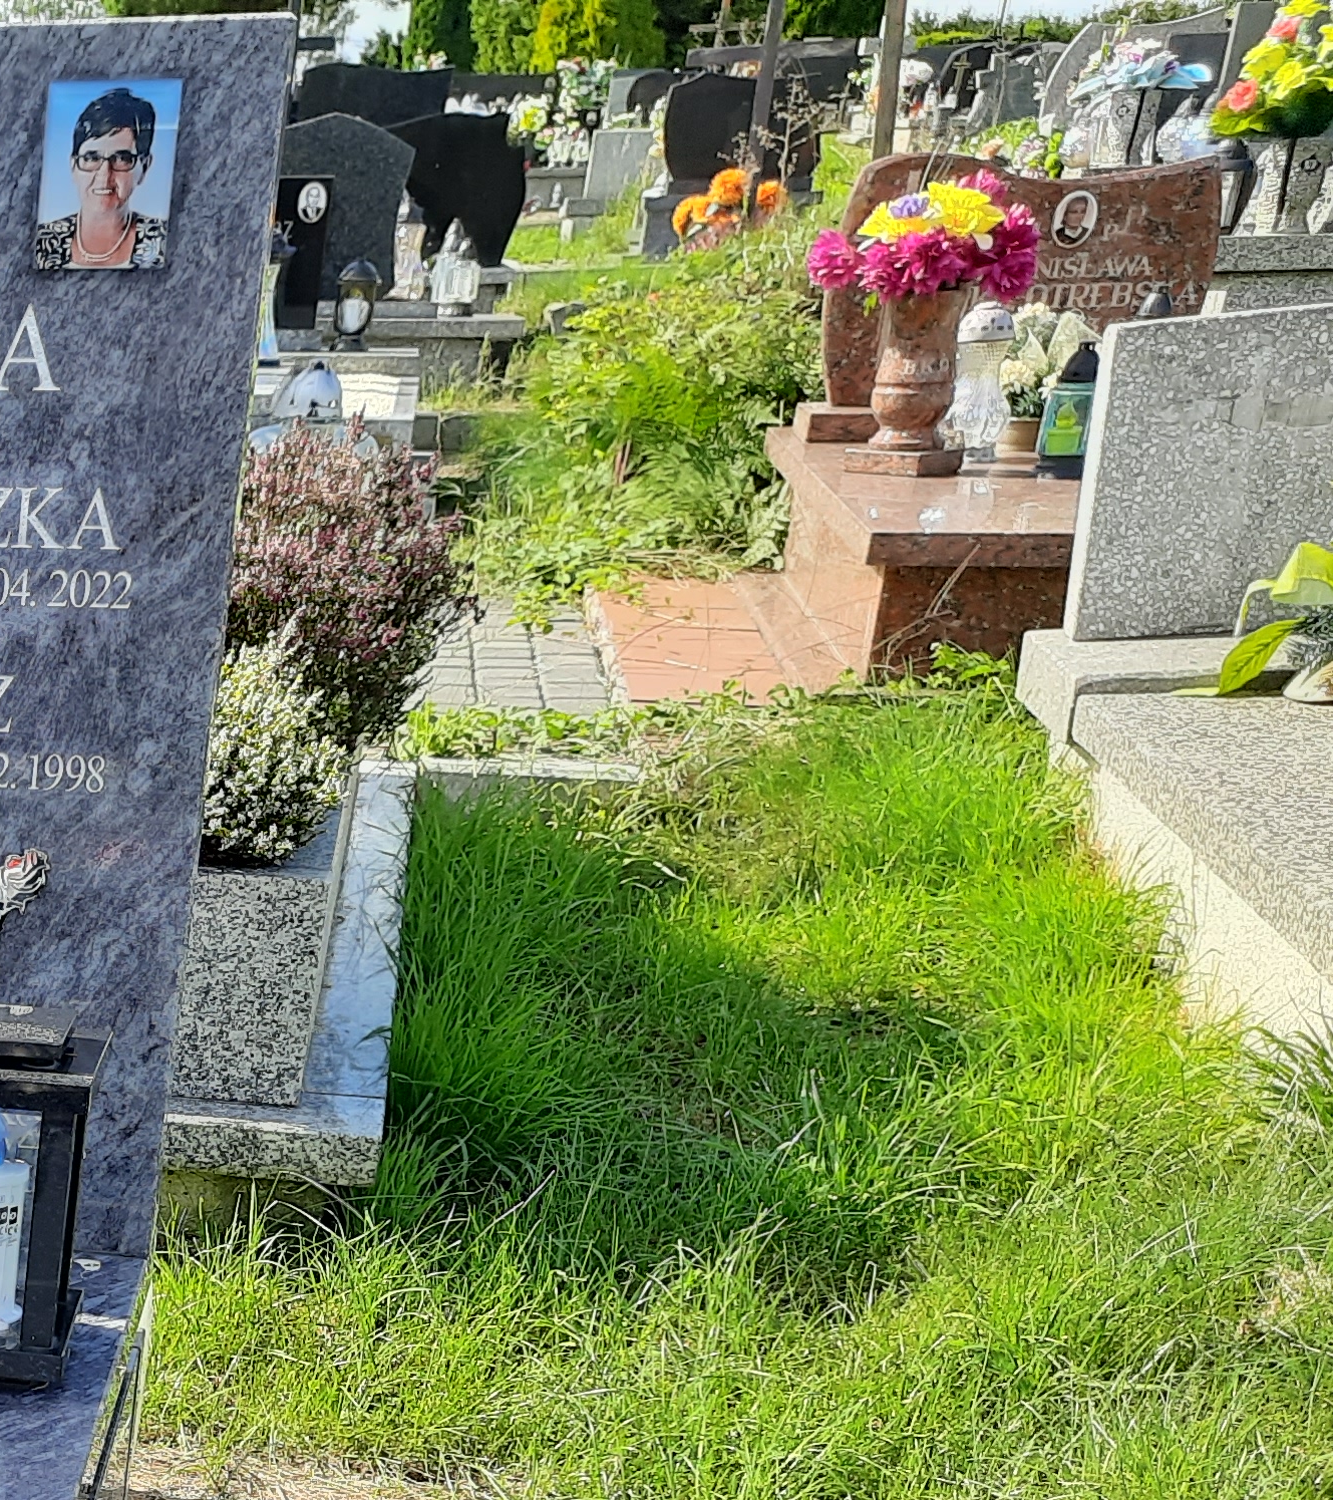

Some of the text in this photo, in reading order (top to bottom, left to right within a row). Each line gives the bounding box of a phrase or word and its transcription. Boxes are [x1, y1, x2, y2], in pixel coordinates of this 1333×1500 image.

[1032, 256, 1152, 280] NISŁAWA
[46, 569, 133, 610] 2022
[28, 752, 106, 794] 1998
